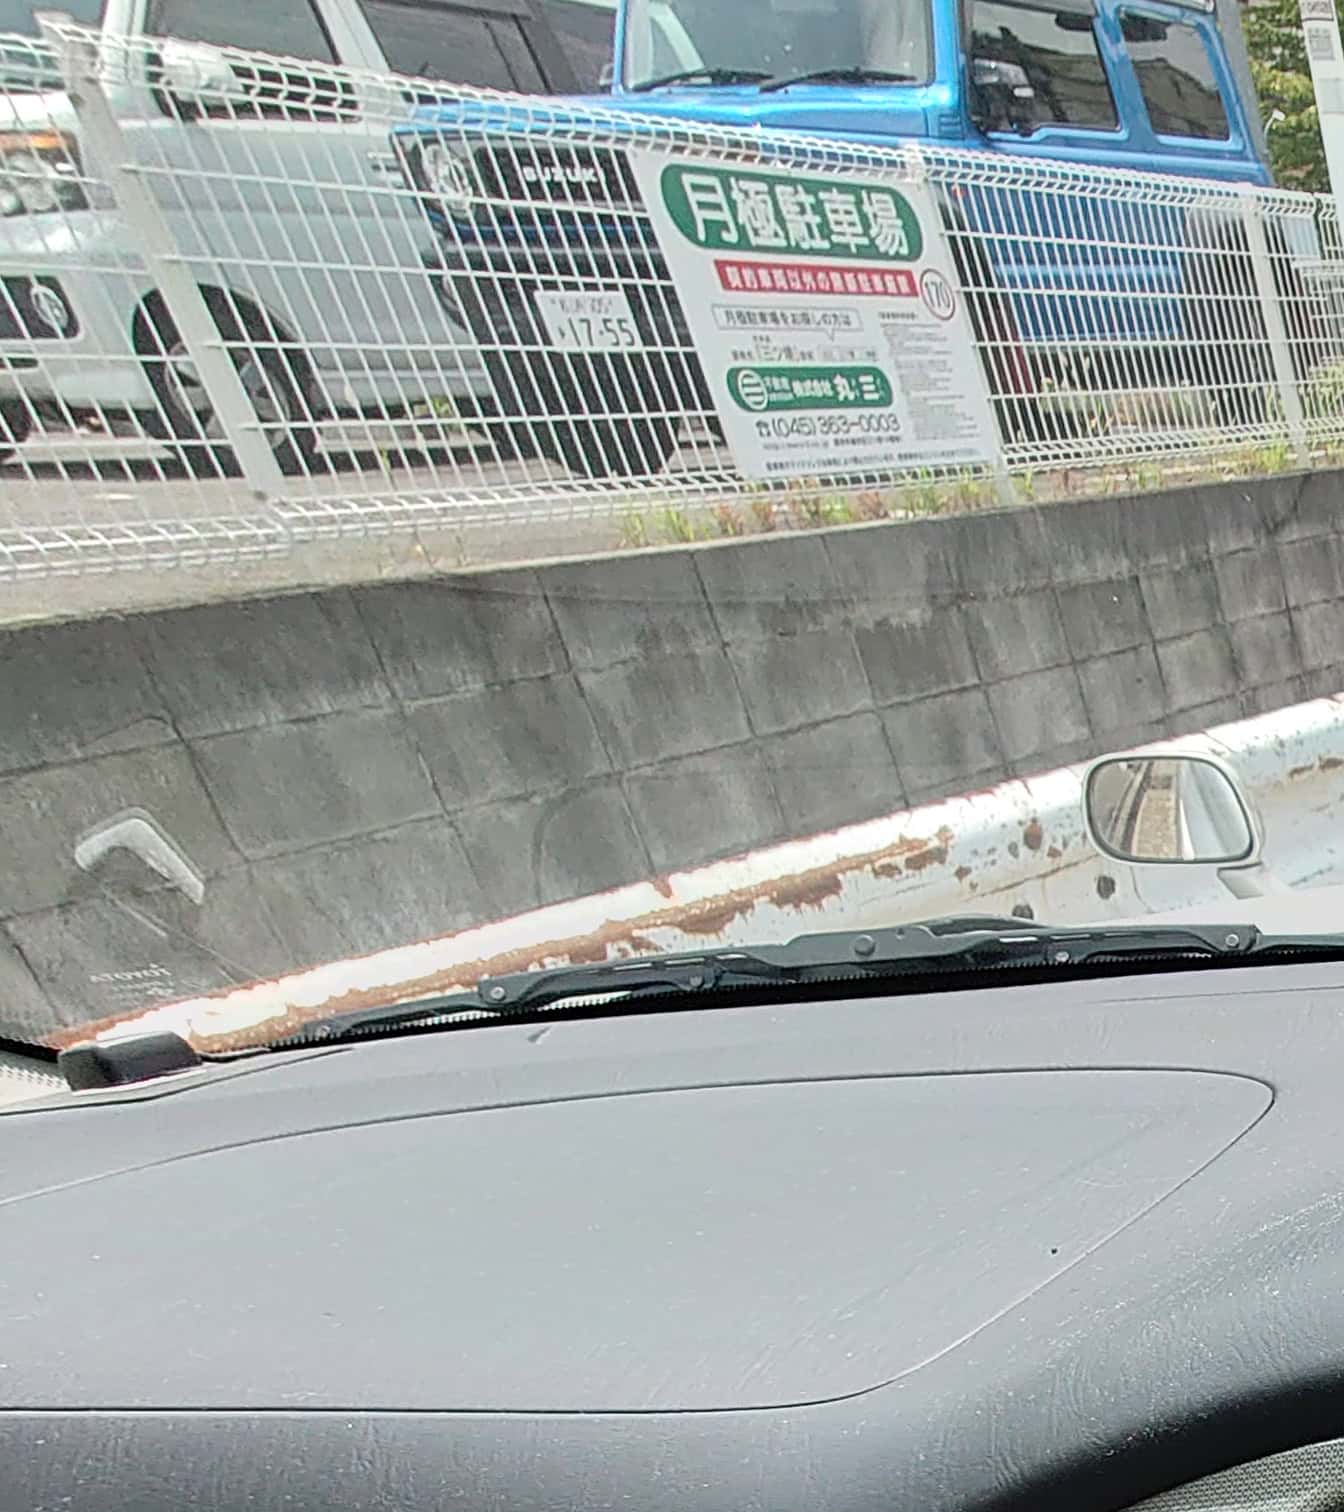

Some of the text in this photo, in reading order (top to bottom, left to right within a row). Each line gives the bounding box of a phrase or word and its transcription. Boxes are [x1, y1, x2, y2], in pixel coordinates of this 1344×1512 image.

[681, 173, 908, 255] 月極駐車場
